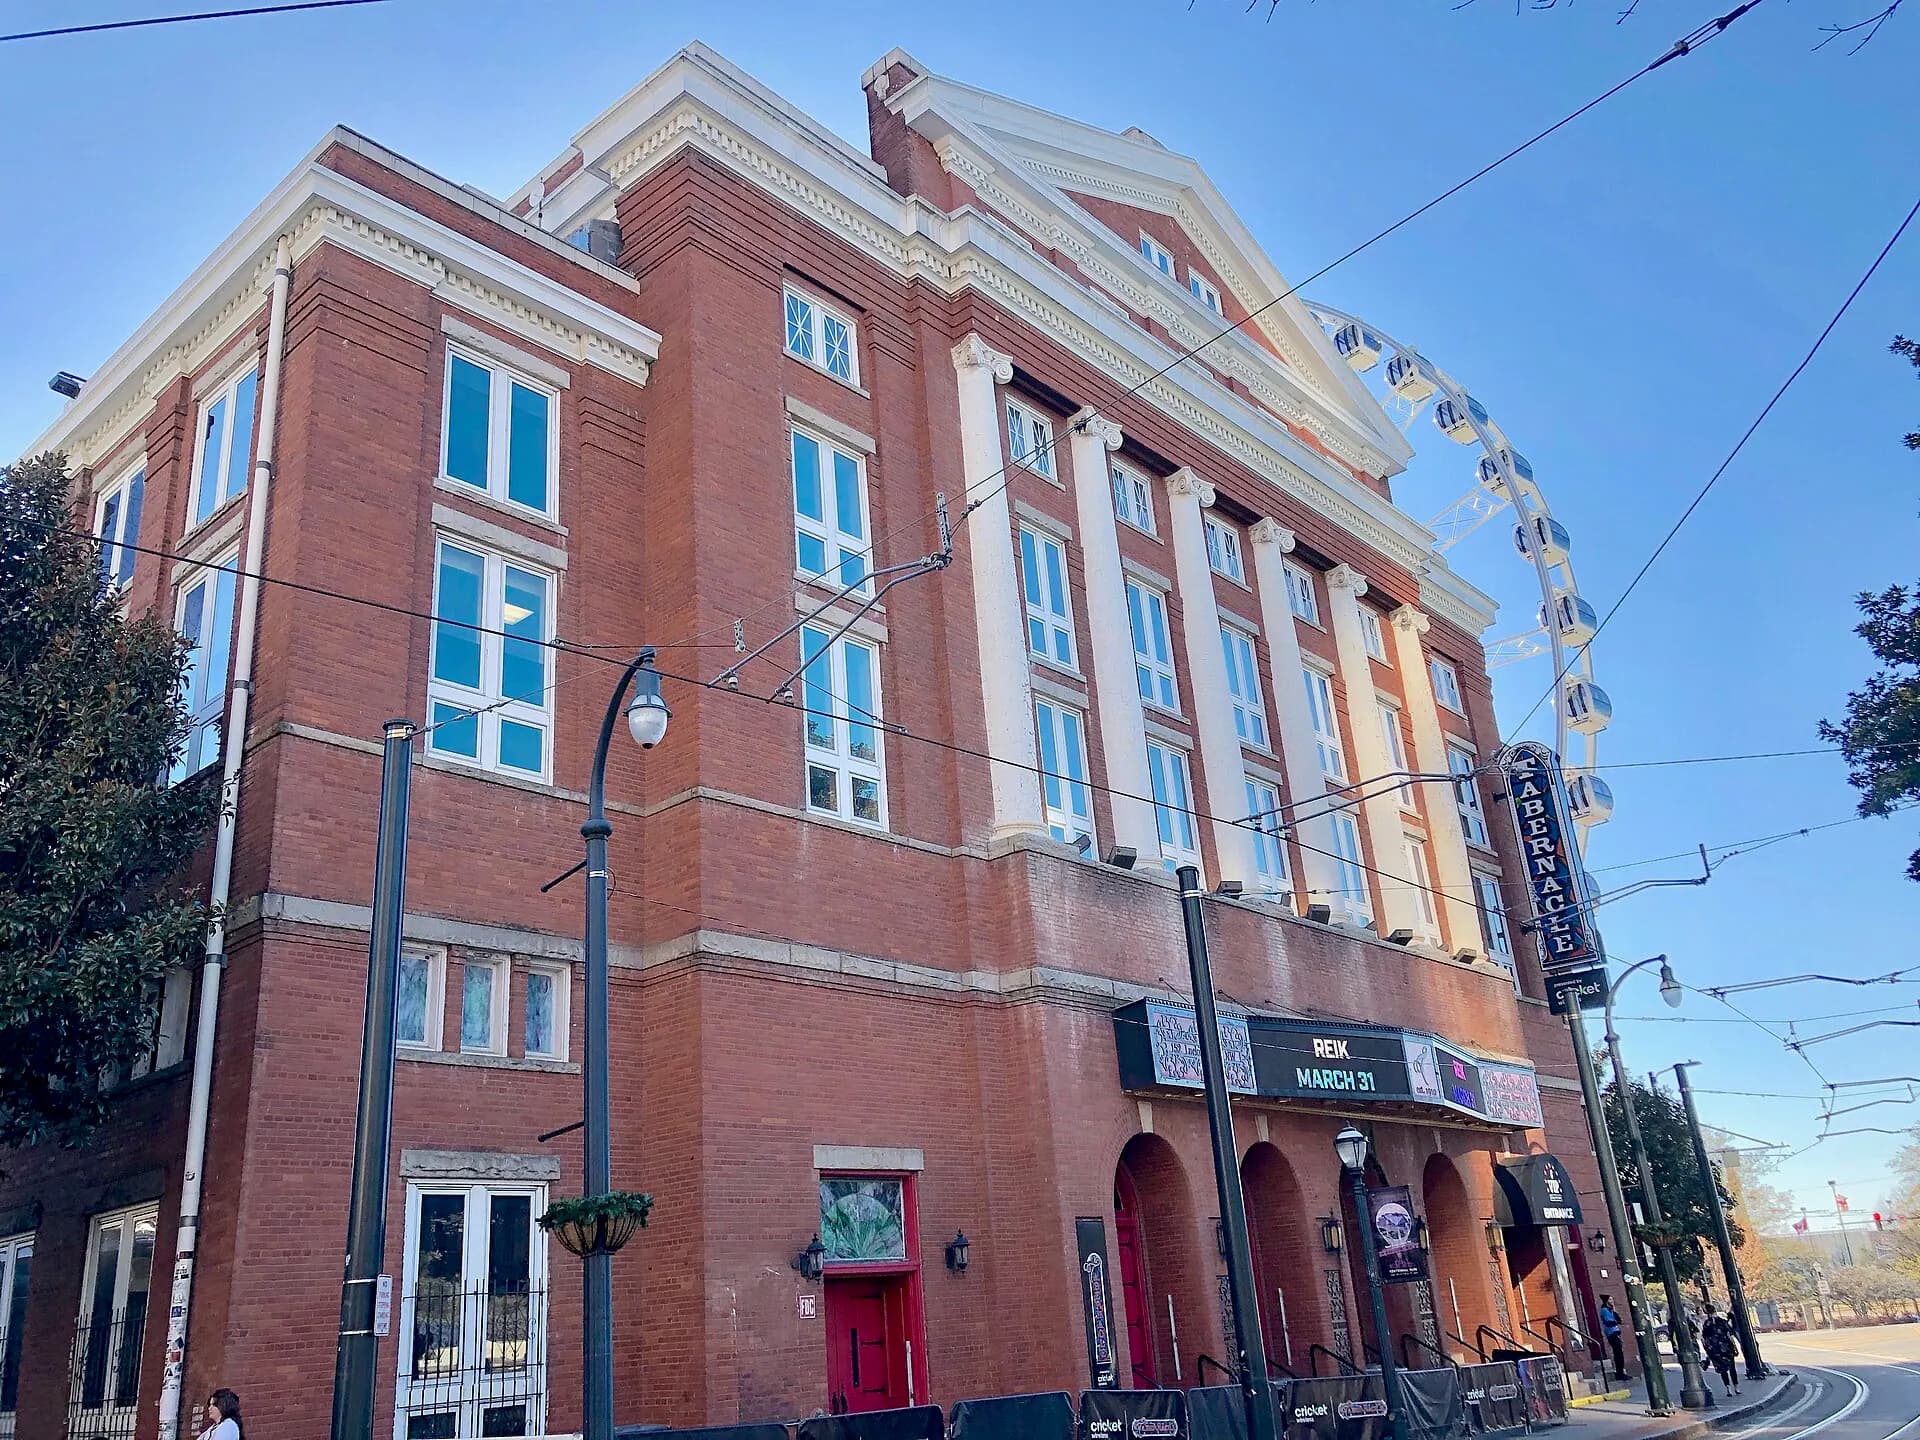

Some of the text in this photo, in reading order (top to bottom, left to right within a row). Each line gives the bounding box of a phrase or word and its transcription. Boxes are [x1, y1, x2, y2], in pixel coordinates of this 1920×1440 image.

[1514, 757, 1574, 953] TABERNACLE
[1556, 982, 1601, 999] cket
[1313, 1038, 1351, 1059] REIK
[1296, 1068, 1376, 1091] MARCH 31
[1543, 1207, 1575, 1219] ENTRANCE
[801, 1298, 814, 1315] FDC
[1294, 1404, 1328, 1417] cricket
[1090, 1419, 1122, 1432] cricket
